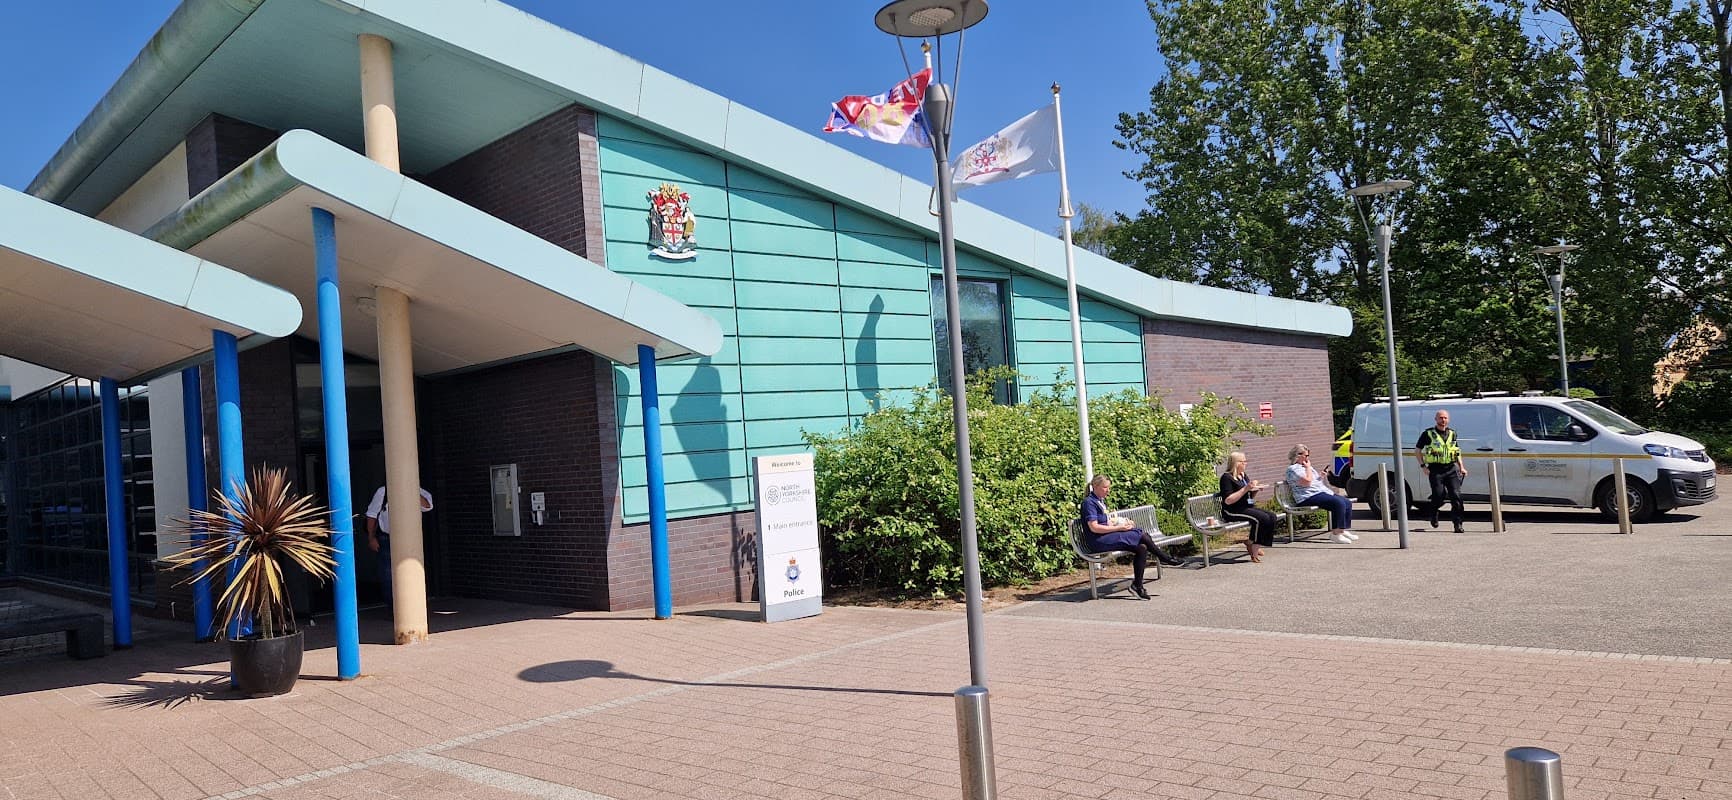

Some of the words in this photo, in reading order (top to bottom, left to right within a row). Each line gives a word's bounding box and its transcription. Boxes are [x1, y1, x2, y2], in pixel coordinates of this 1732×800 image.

[781, 488, 810, 497] YORKSHIRE
[781, 496, 806, 504] COUNCIL
[773, 522, 788, 530] Main
[789, 520, 813, 529] entrance
[783, 588, 805, 598] Police
